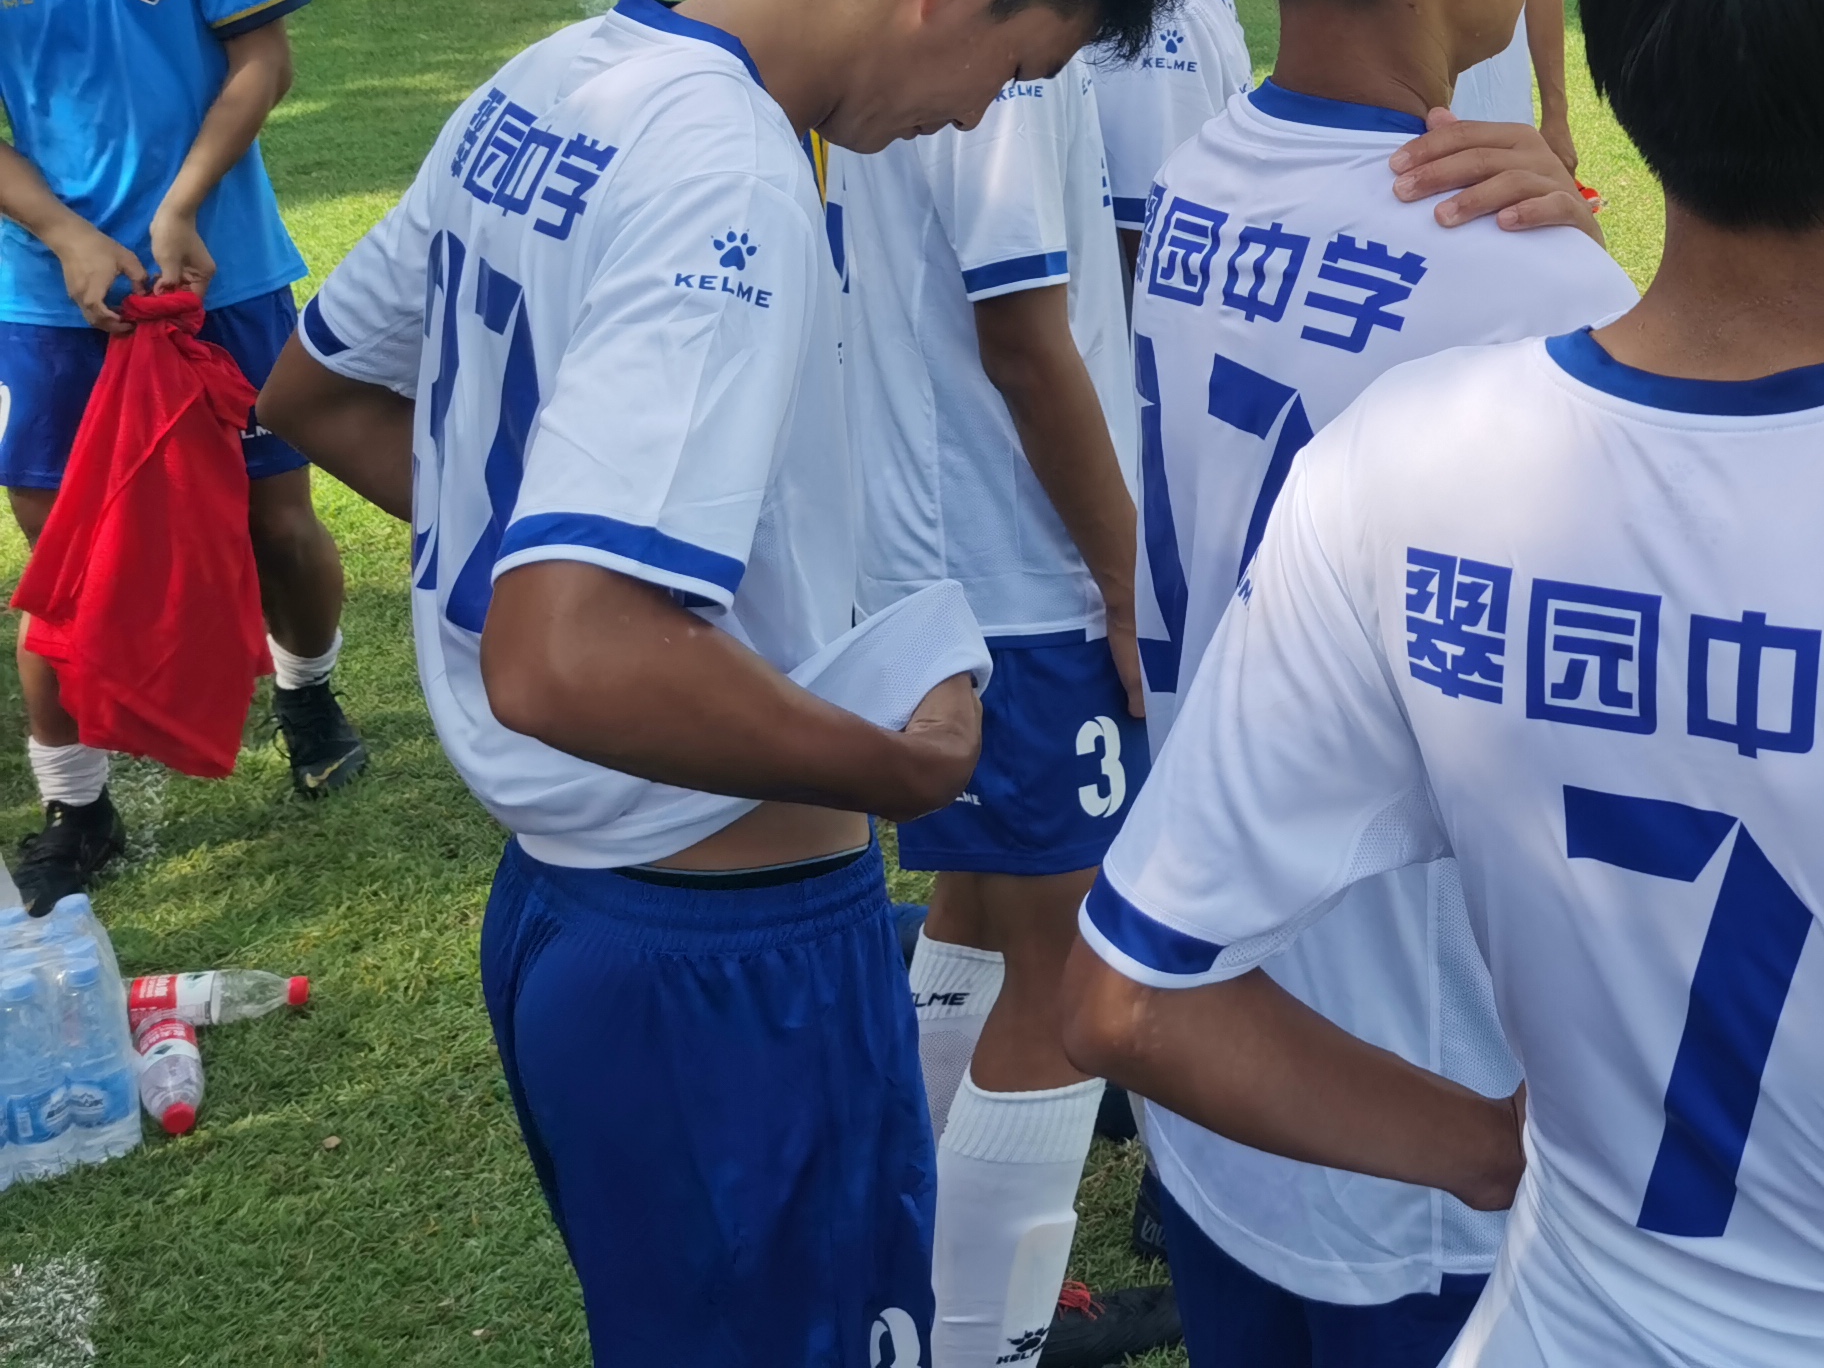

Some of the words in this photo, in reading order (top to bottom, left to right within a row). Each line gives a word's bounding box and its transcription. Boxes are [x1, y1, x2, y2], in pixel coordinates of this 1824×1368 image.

[1143, 56, 1198, 73] KELME
[996, 83, 1043, 102] KELME
[674, 273, 773, 309] KELME
[1076, 716, 1126, 819] 3
[1563, 784, 1814, 1238] 7
